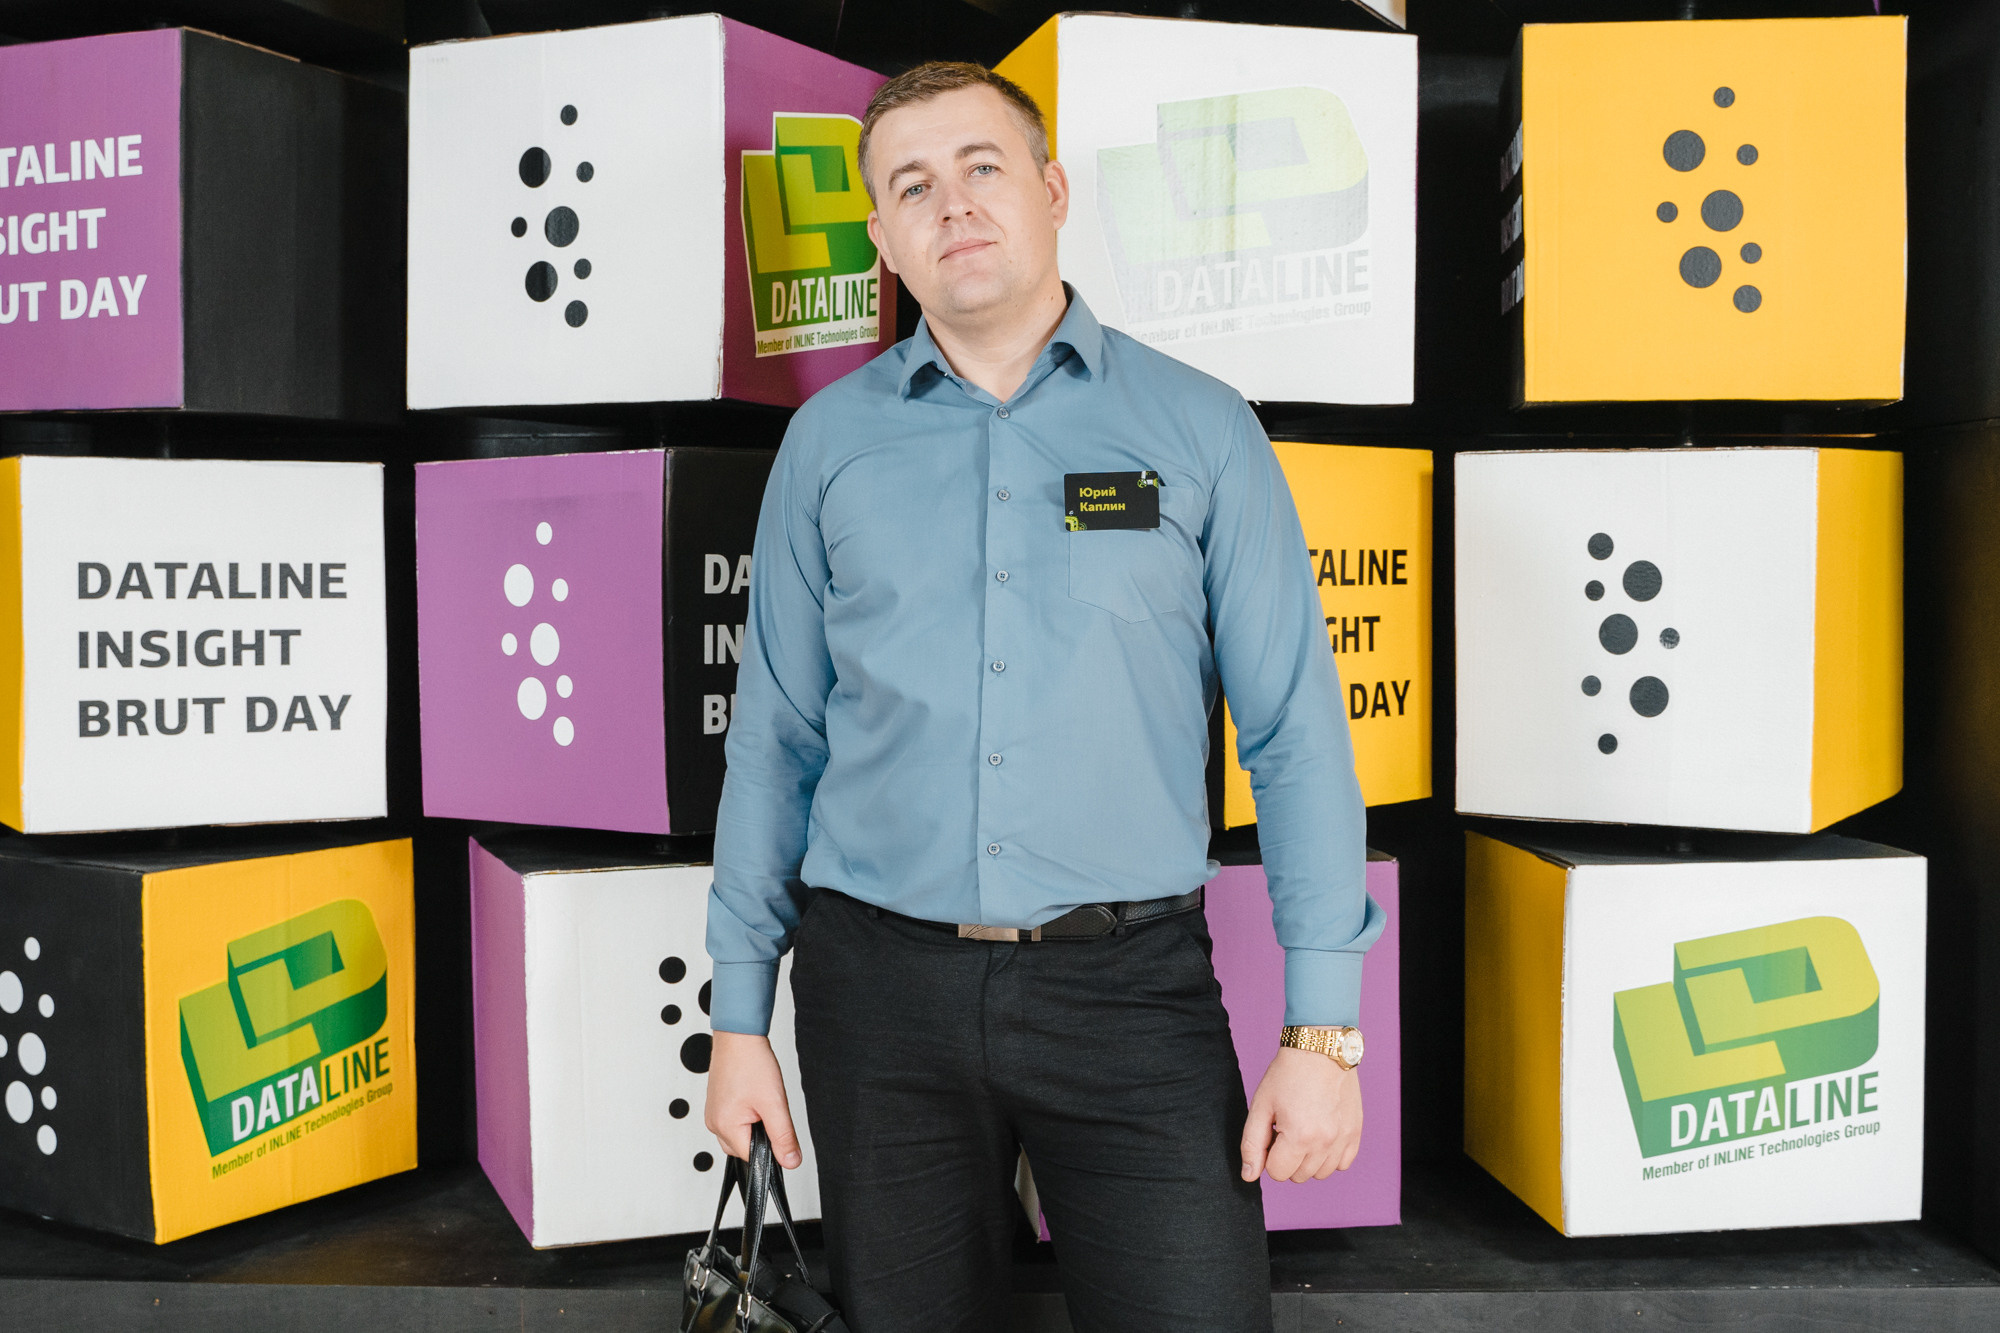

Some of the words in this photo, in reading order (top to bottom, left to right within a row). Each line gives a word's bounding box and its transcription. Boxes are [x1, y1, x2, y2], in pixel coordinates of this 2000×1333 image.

[0, 207, 106, 256] IGHT
[60, 274, 148, 320] DAY
[772, 277, 878, 325] DATALINE
[1156, 249, 1370, 315] DATALINE
[757, 338, 784, 355] Member
[786, 336, 792, 350] of
[794, 332, 815, 349] INLINE
[817, 328, 857, 345] Technologies
[860, 325, 878, 339] Group
[1184, 323, 1197, 338] of
[1201, 317, 1243, 337] INLINE
[1334, 301, 1371, 316] Group
[1079, 486, 1117, 499] Юрий
[1080, 501, 1126, 512] Каплин
[78, 562, 348, 599] DATALINE
[78, 629, 302, 669] INSIGHT
[78, 697, 226, 738] BRUT
[246, 694, 352, 733] DAY
[703, 693, 736, 735] B
[1350, 679, 1411, 720] DAY
[231, 1036, 390, 1143] DATALINE
[1670, 1071, 1879, 1149] DATALINE
[212, 1150, 254, 1180] Member
[257, 1142, 267, 1158] of
[269, 1126, 302, 1151] INLINE
[304, 1097, 364, 1135] Technologies
[367, 1082, 393, 1103] Group
[1642, 1160, 1694, 1181] Member
[1698, 1155, 1710, 1169] of
[1714, 1145, 1754, 1167] INLINE
[1760, 1128, 1840, 1157] Technologies
[1844, 1121, 1880, 1138] Group
